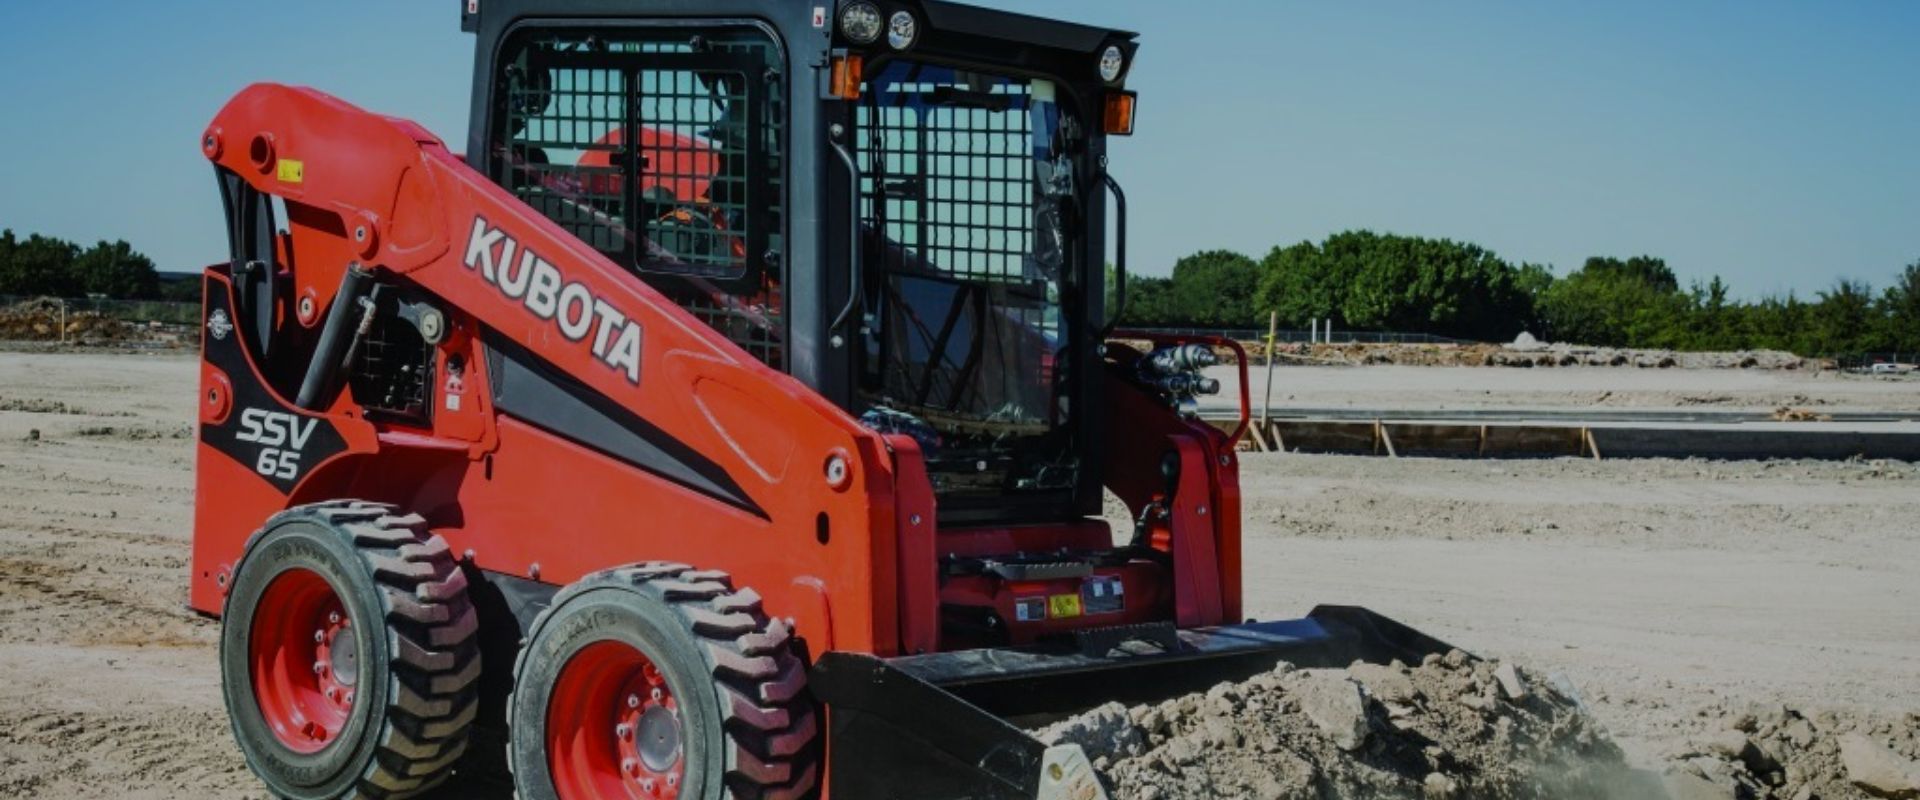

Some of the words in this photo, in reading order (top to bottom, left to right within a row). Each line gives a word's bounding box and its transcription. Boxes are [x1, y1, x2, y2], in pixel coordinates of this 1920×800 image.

[464, 215, 643, 386] KUBOTA
[236, 407, 318, 450] SSV
[256, 447, 301, 480] 65
